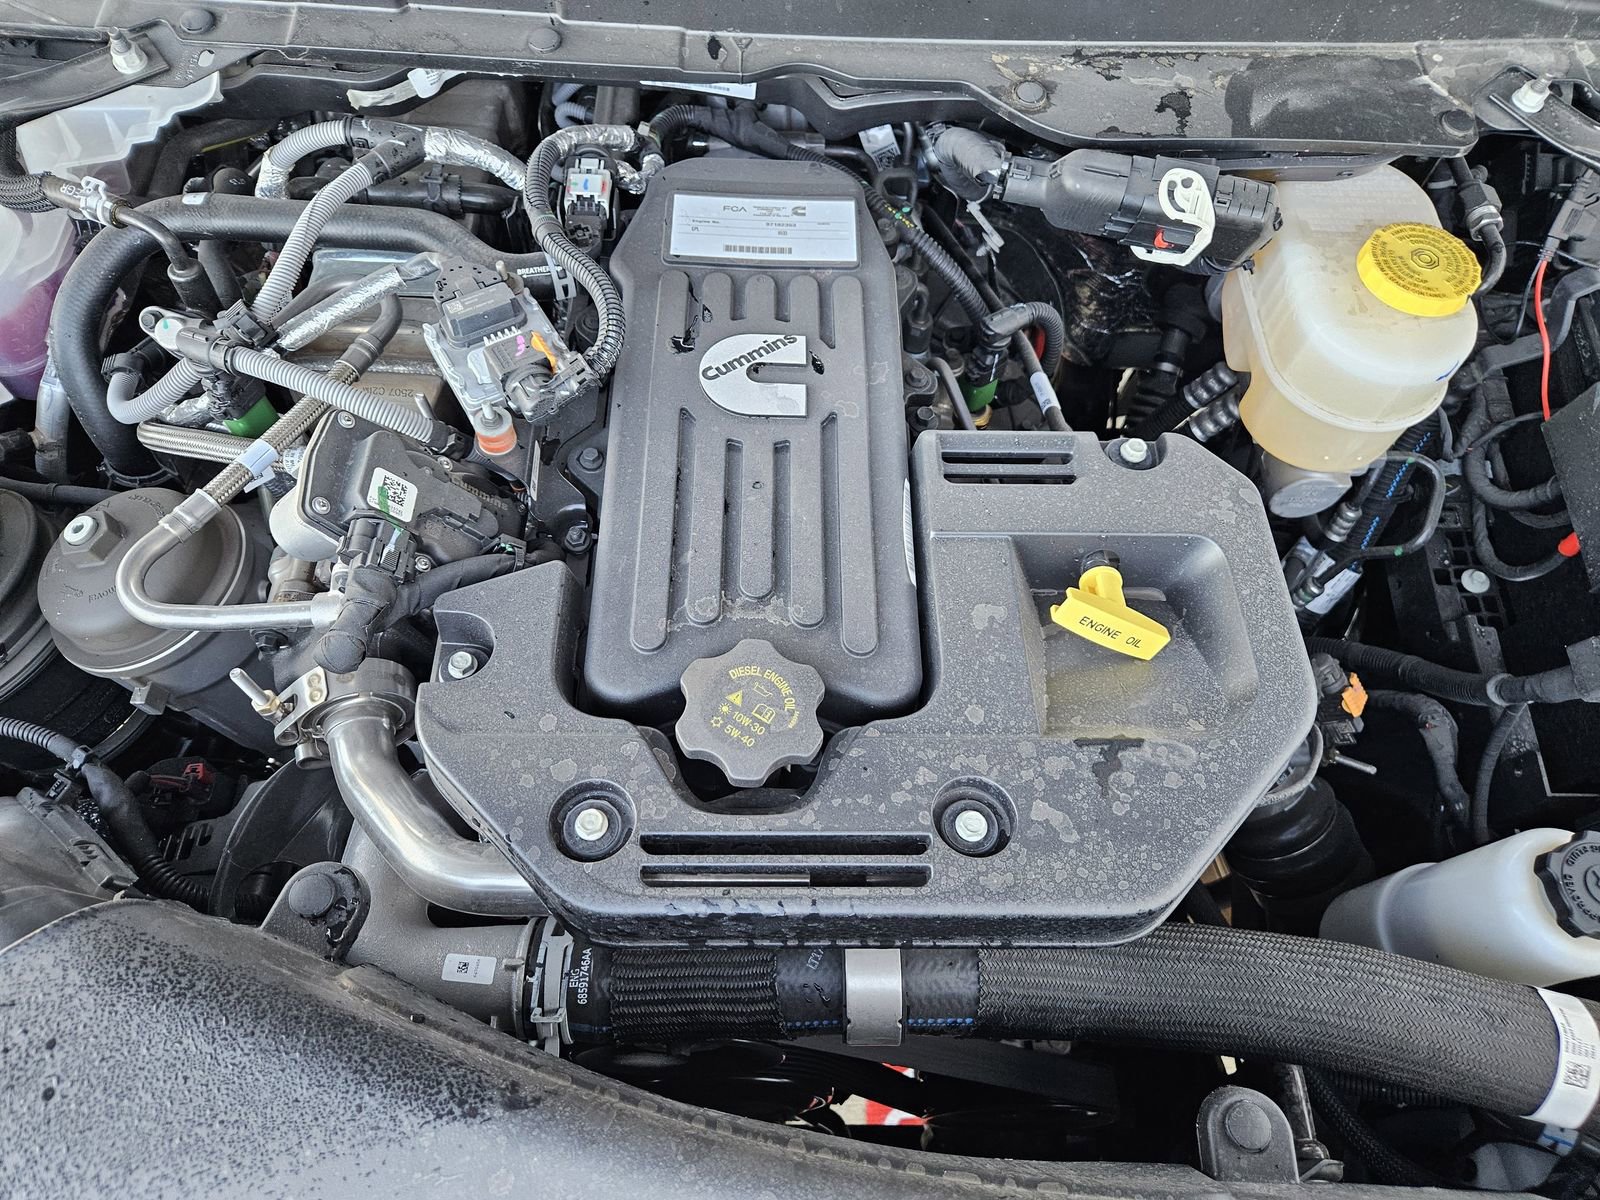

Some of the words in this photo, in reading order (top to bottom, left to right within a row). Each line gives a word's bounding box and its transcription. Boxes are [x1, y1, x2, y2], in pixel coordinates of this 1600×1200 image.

[702, 334, 798, 380] Cummins
[389, 388, 414, 398] 2507
[1079, 616, 1122, 640] ENGINE
[1126, 636, 1142, 649] OIL
[729, 666, 762, 680] DIESEL
[763, 670, 793, 697] ENGINE
[784, 698, 796, 712] OIL
[724, 724, 755, 747] 5W-40
[732, 711, 766, 736] 10W-30
[569, 968, 580, 988] ENG
[577, 947, 592, 1004] 68591746AA
